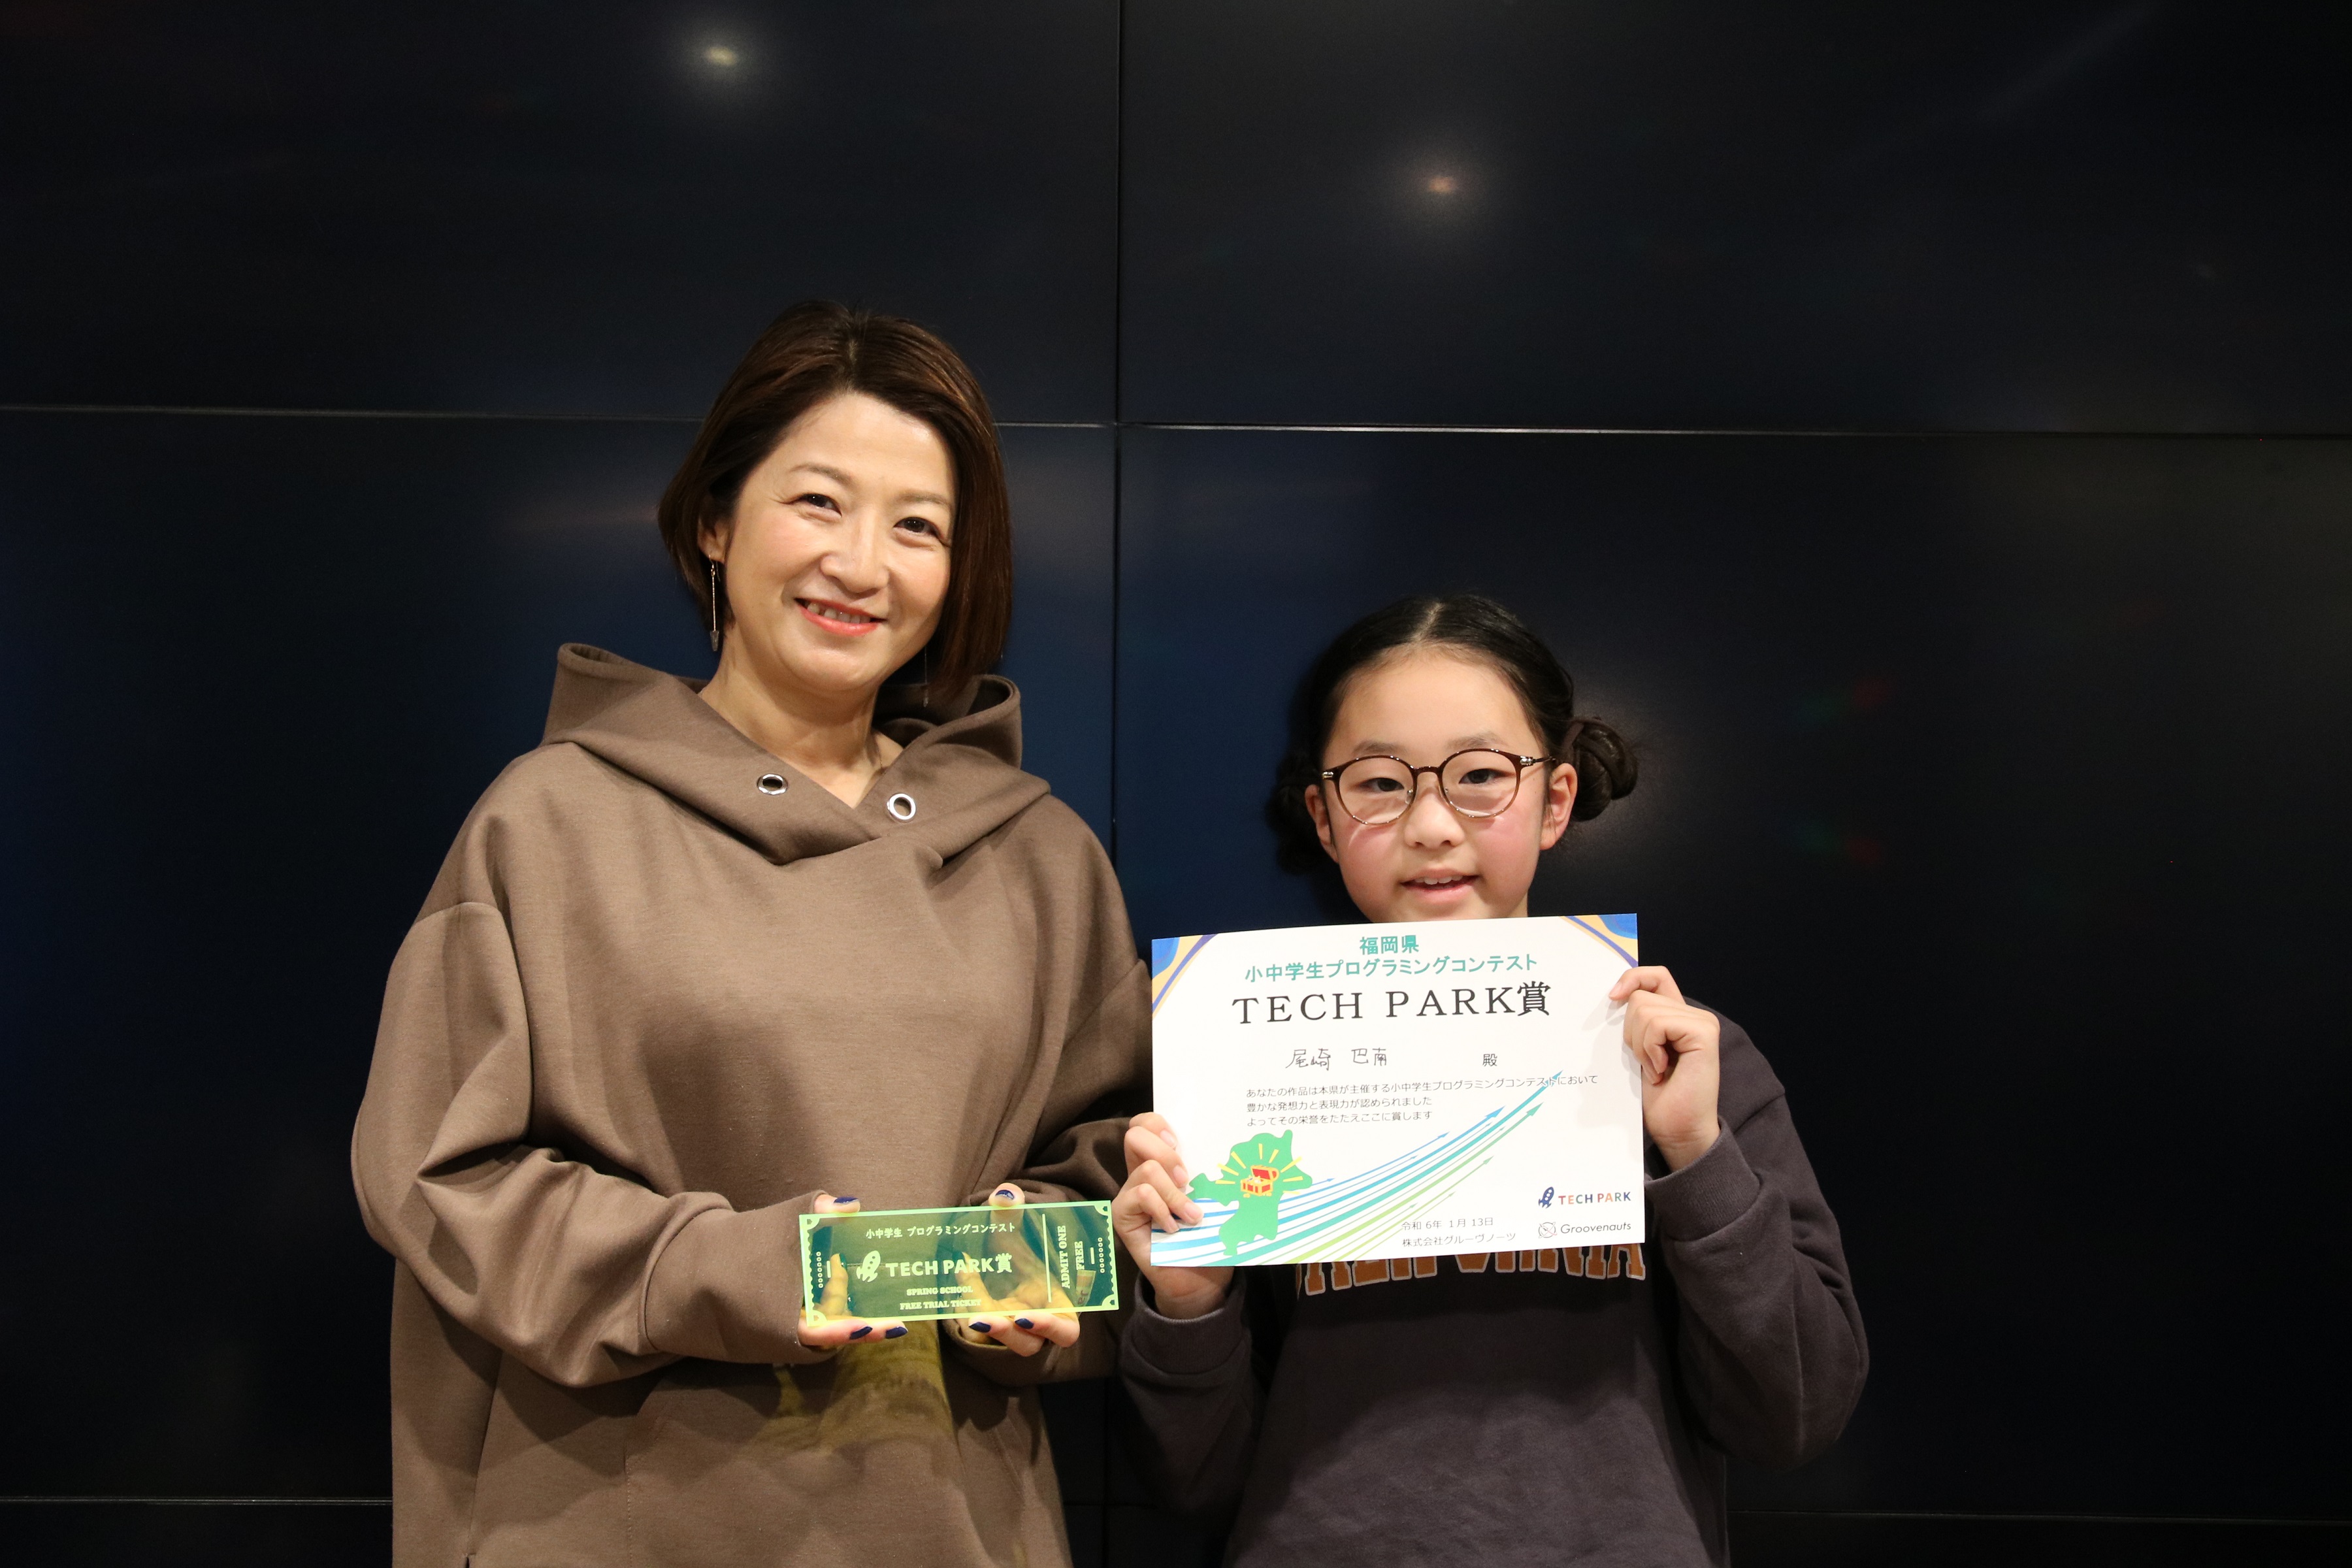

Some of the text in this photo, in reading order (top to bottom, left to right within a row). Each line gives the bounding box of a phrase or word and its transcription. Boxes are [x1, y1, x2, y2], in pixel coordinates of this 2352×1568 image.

[1360, 935, 1419, 955] 福岡県
[1245, 954, 1537, 983] 小中学生プログラミングコンテスト
[1232, 980, 1552, 1024] TECH PARK賞
[1482, 1053, 1498, 1067] 殿
[1247, 1096, 1432, 1113] 豊かな発想力と表現力が認められました
[1558, 1191, 1631, 1205] TECH PARK
[866, 1222, 1015, 1239] 小中学生 プログラミングコンテスト
[1401, 1220, 1422, 1231] 令和
[1471, 1217, 1494, 1227] 13日
[1560, 1222, 1631, 1234] Groovenauts
[1401, 1233, 1516, 1248] 株式会社グルーヴノーツ
[885, 1252, 1013, 1277] TECH PARK賞
[1057, 1225, 1070, 1289] ADMIT ONE
[1074, 1241, 1085, 1271] FREE
[906, 1286, 973, 1296] SPRING SCHOOL
[900, 1299, 981, 1311] FREE TRIAL TICKET
